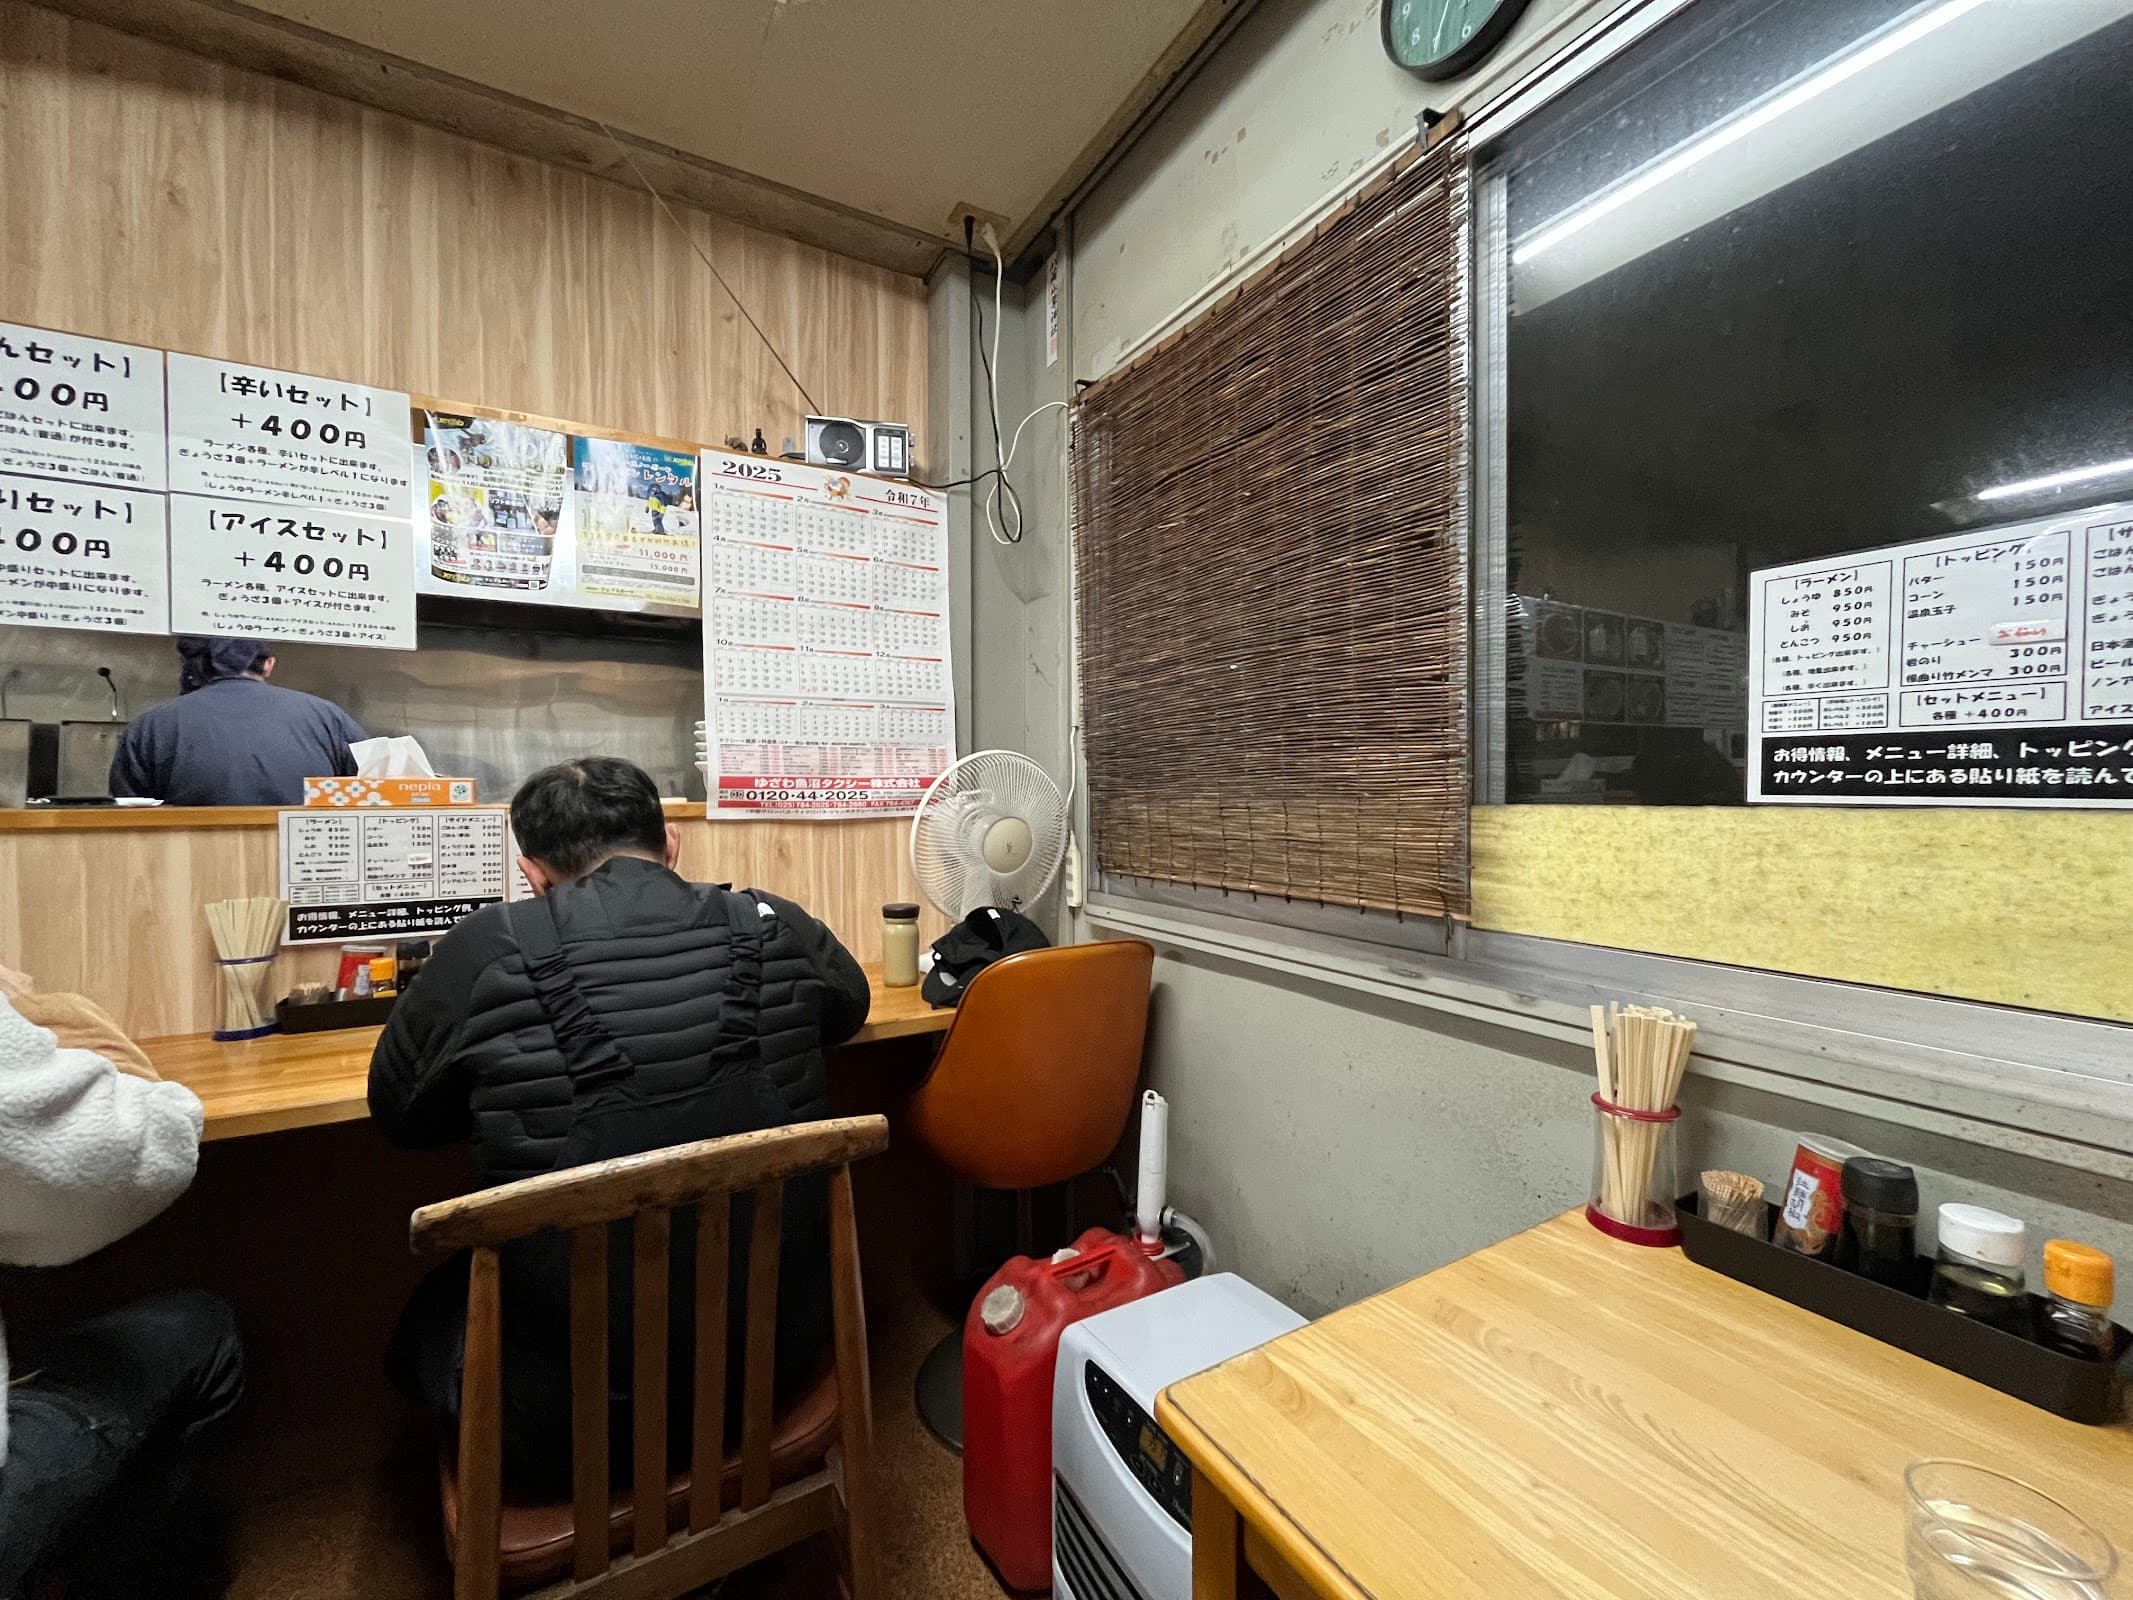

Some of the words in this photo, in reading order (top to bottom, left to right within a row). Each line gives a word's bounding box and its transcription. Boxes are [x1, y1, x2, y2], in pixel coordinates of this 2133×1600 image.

[1402, 3, 1411, 21] 9
[1411, 27, 1420, 46] 8
[1461, 19, 1472, 39] 6
[0, 377, 108, 412] 00円
[231, 413, 366, 449] +400円
[722, 460, 783, 482] 2025
[885, 489, 930, 508] 令和7年
[0, 527, 111, 558] 00円
[234, 551, 370, 581] +400円
[1908, 576, 1945, 586] バター
[2014, 557, 2064, 571] 150円
[1781, 593, 1821, 605] しょうゆ
[1833, 586, 1873, 598] 850円
[1909, 591, 1944, 602] コーン
[2013, 575, 2064, 589] 150円
[1790, 609, 1810, 618] みそ
[1832, 601, 1873, 612] 950円
[1907, 605, 1957, 619] 温泉玉子
[2013, 593, 2063, 607] 150円
[1832, 617, 1872, 627] 950円
[1780, 638, 1820, 649] とんこつ
[1832, 632, 1872, 643] 950円
[1907, 637, 1981, 651] チャーシュー
[2009, 646, 2062, 659] 300円
[2009, 663, 2061, 676] 300円
[399, 783, 441, 792] nepia
[755, 777, 921, 789] ゆざわ魚沼タクシー株式会社
